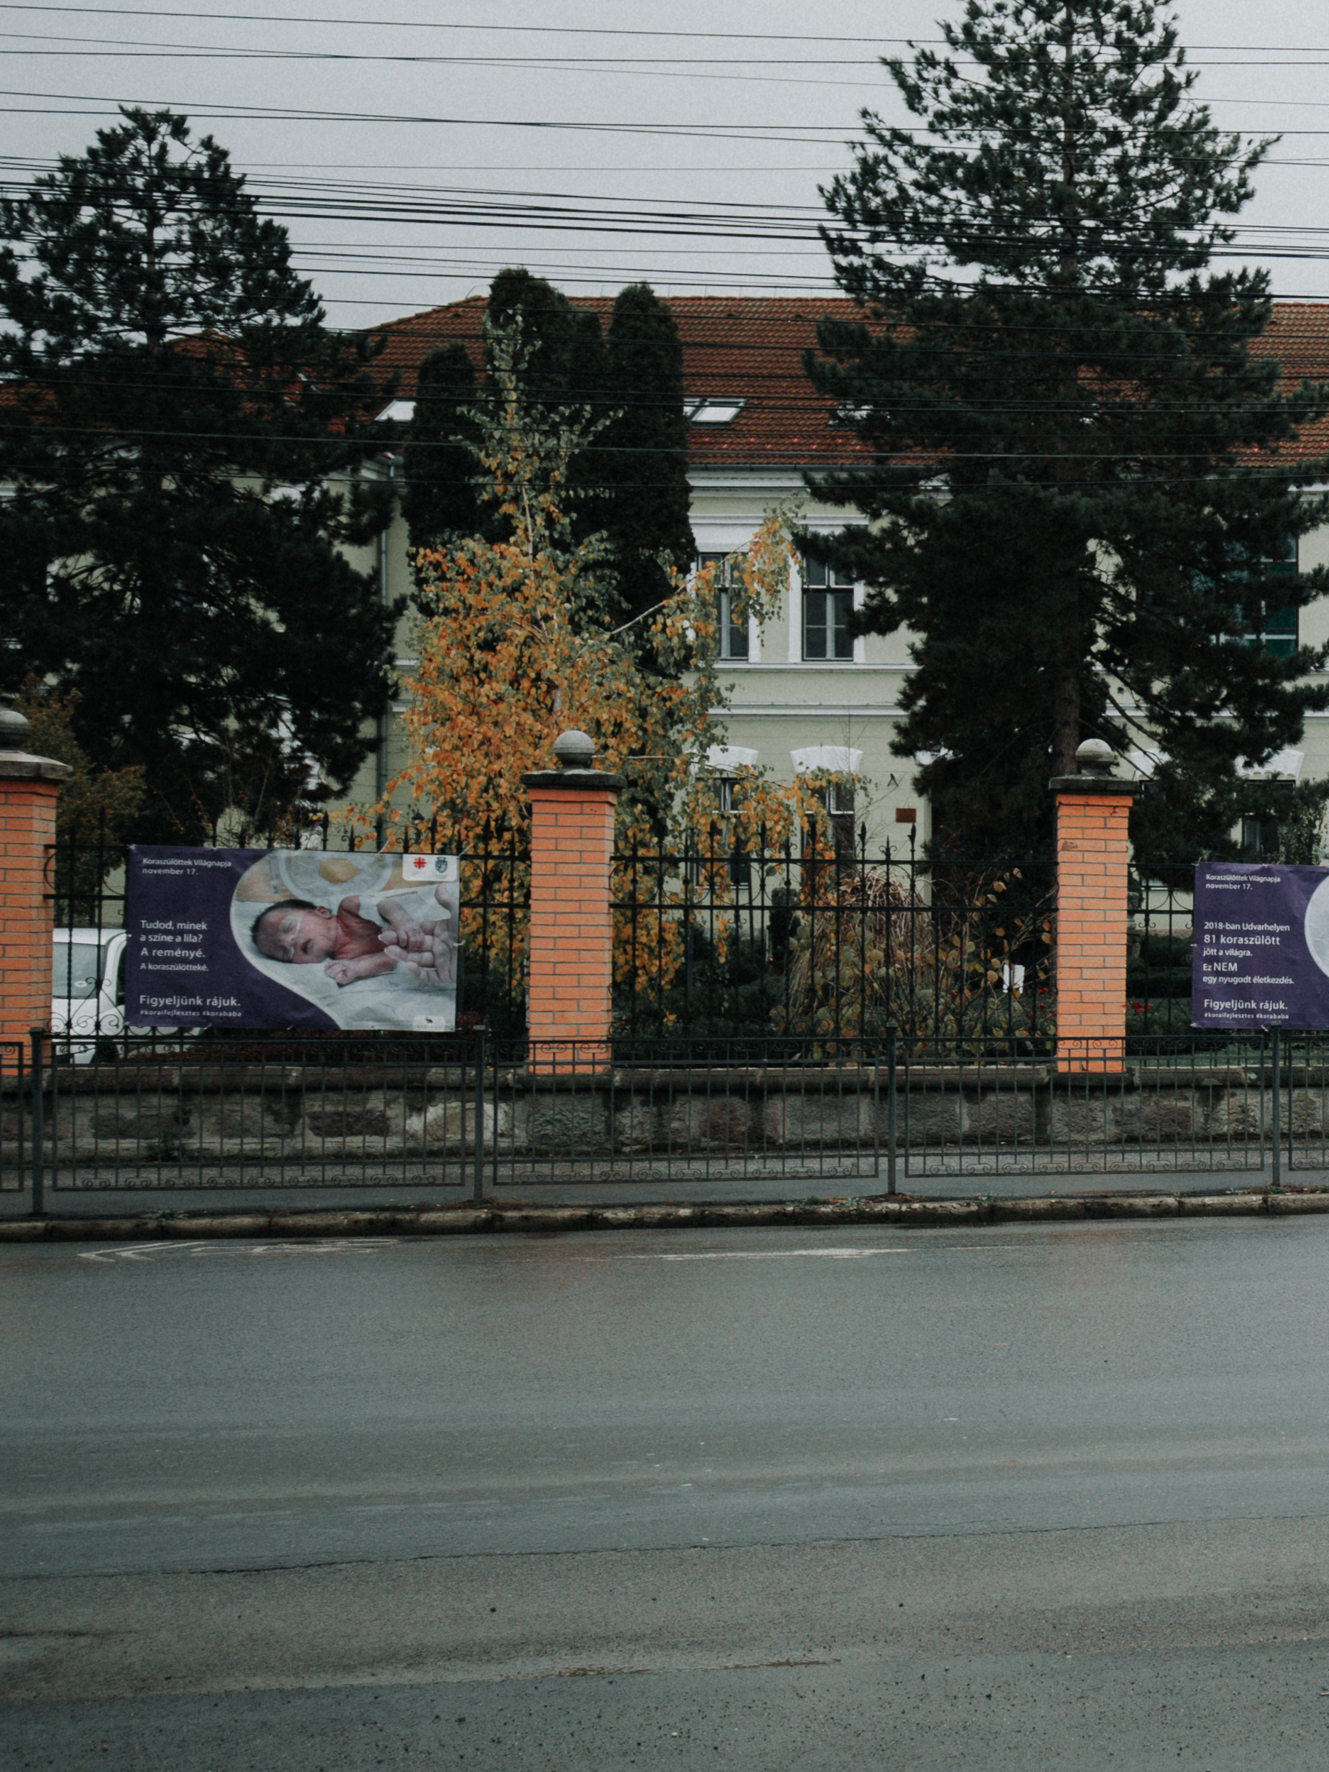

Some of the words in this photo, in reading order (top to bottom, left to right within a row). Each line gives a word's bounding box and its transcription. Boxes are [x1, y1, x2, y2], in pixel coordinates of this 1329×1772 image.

[142, 858, 193, 866] Koraszülöttek
[193, 859, 232, 868] Világnapja
[1205, 873, 1248, 882] Koraszülöttek
[1248, 875, 1281, 884] Világnapja
[140, 920, 174, 930] Tudod,
[176, 921, 208, 930] minek
[1203, 921, 1241, 930] 2018-ban
[1241, 922, 1291, 933] Udvarhelyen
[148, 933, 174, 942] színe
[183, 934, 203, 943] lila?
[1203, 934, 1217, 944] 81
[1219, 934, 1281, 946] koraszülött
[140, 947, 149, 956] A
[152, 947, 206, 960] reményé.
[1202, 947, 1217, 957] jött
[1224, 948, 1253, 958] világra.
[140, 962, 147, 970] A
[148, 962, 209, 971] koraszülötteké.
[1202, 963, 1212, 971] Ez
[1213, 962, 1238, 972] NEM
[1202, 975, 1217, 985] egy
[1218, 975, 1252, 985] nyugodt
[1252, 975, 1295, 985] életkezdés.
[139, 995, 203, 1007] Figyeljünk
[206, 996, 241, 1008] rájuk.
[1204, 999, 1257, 1011] Figyeljünk
[1259, 1000, 1289, 1011] rájuk.
[140, 1009, 200, 1017] #koraifejlesztes
